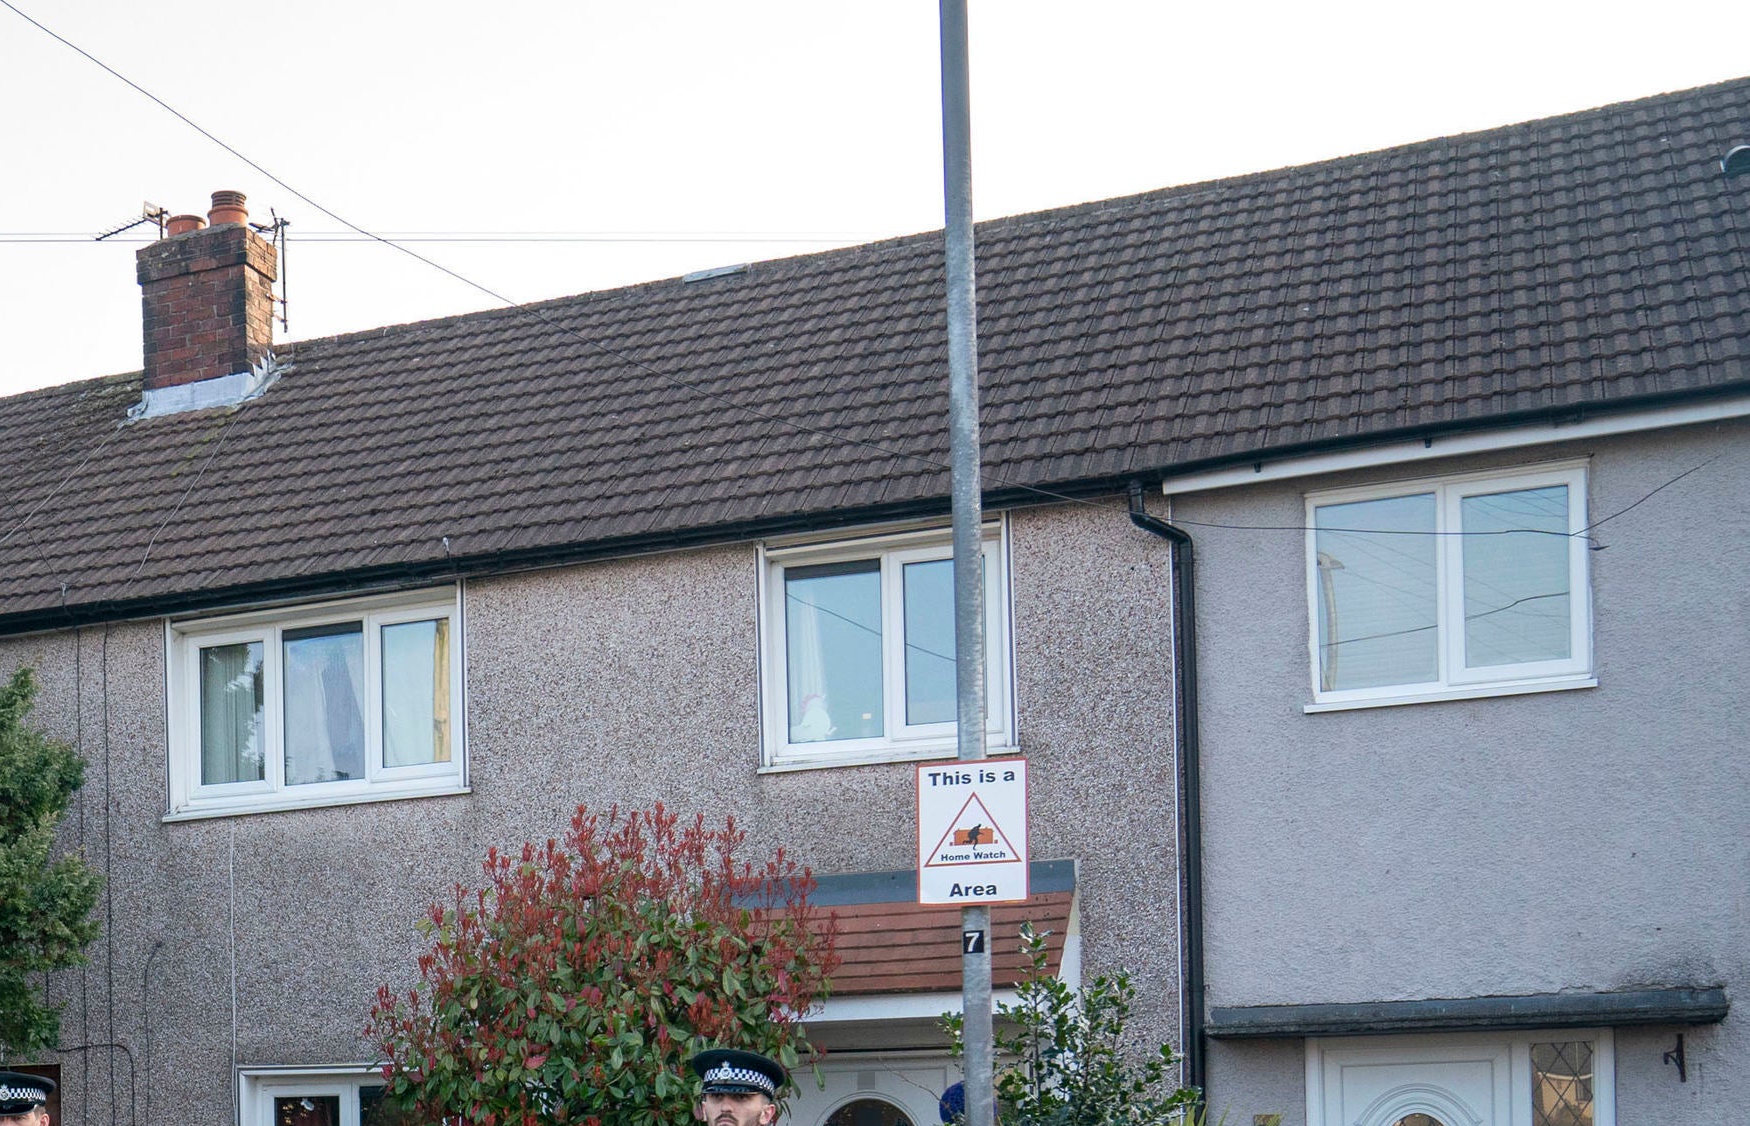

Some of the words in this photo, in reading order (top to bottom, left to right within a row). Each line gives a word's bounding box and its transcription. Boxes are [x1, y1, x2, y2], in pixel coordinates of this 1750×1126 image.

[928, 771, 972, 786] This
[979, 769, 996, 783] is
[1003, 770, 1015, 782] a
[940, 853, 970, 862] Home
[973, 850, 1006, 860] Watch
[949, 883, 997, 897] Area
[965, 932, 979, 952] 7
